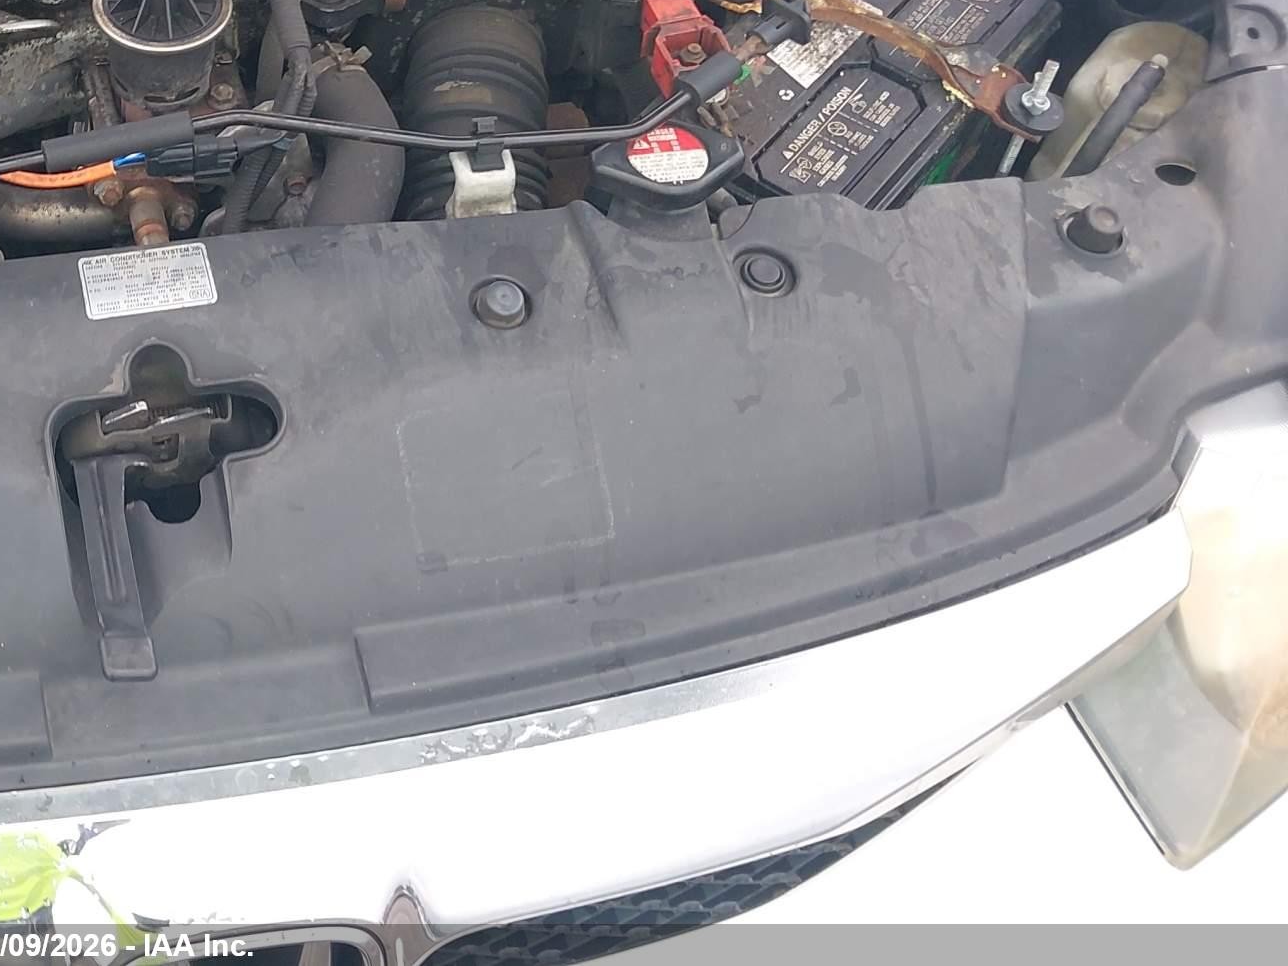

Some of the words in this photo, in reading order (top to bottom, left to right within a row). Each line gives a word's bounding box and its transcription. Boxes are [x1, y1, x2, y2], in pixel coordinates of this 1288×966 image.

[789, 118, 823, 152] DANGER
[821, 86, 853, 116] POISON
[161, 246, 190, 256] SYSTEM
